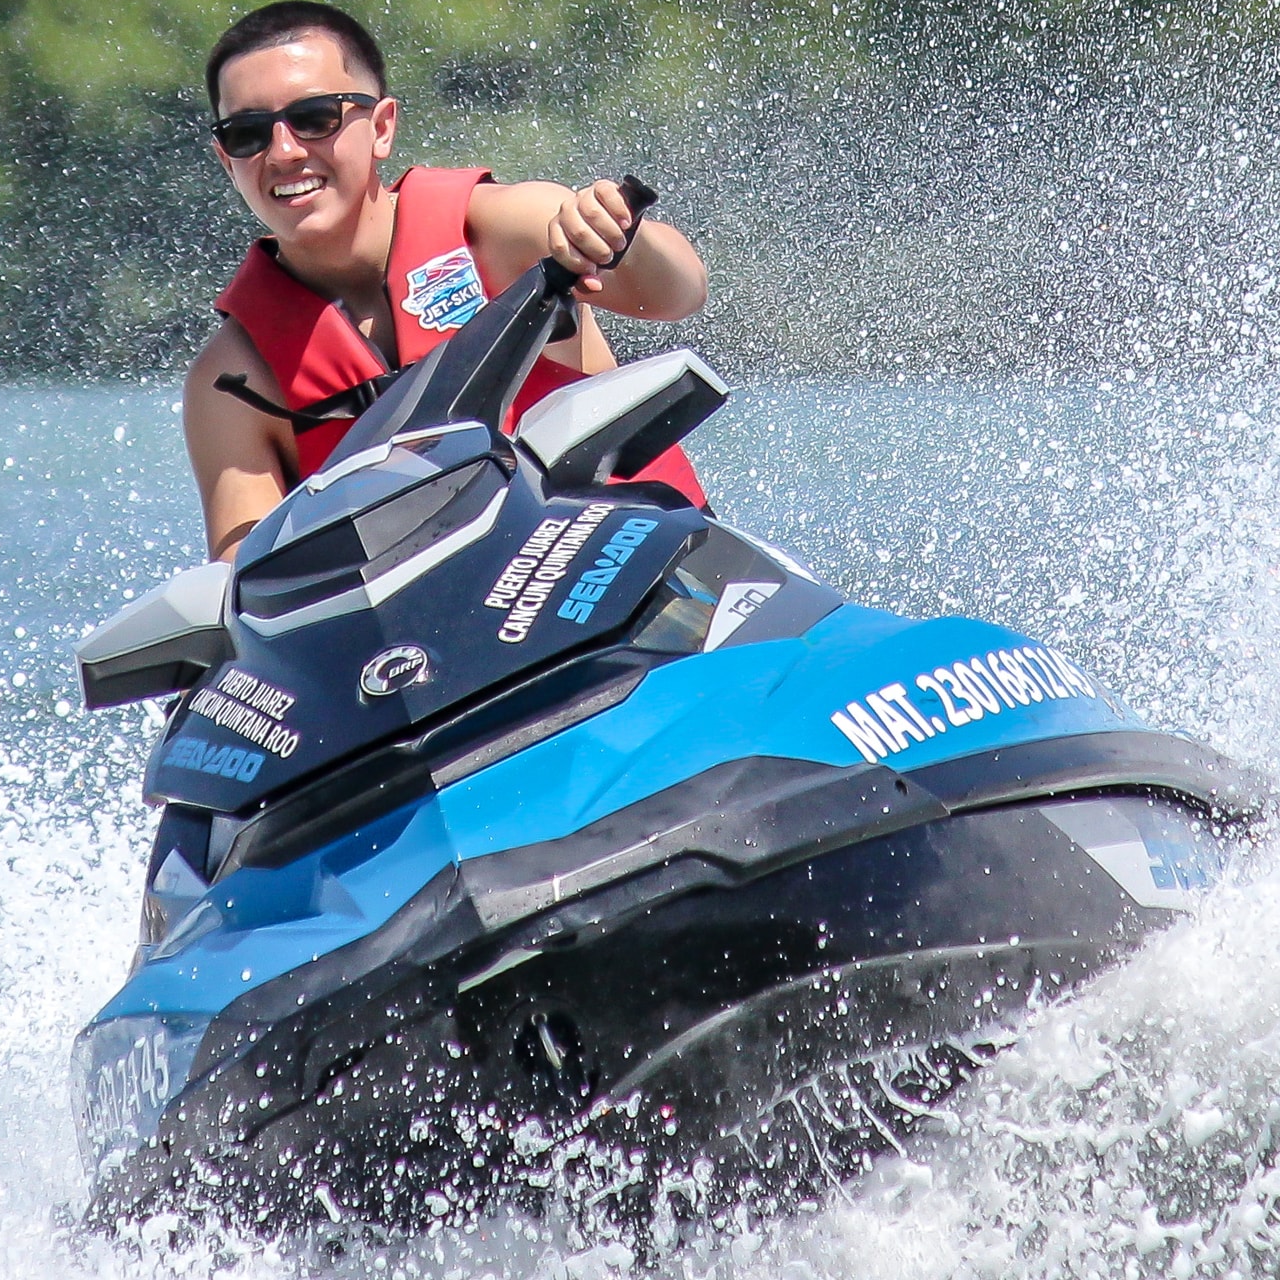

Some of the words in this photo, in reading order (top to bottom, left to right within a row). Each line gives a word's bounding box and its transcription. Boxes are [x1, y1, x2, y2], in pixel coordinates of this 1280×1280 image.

[484, 556, 538, 609] PUERTO
[519, 518, 570, 558] JUAREZ
[497, 580, 555, 643] CANCUN
[535, 520, 595, 581] QUINTANA
[576, 504, 615, 523] ROO
[188, 688, 227, 720] CANCUN
[216, 700, 272, 745] QUINTANA
[262, 724, 300, 759] ROO
[217, 669, 258, 701] PUERTO
[246, 683, 296, 721] JUAREZ
